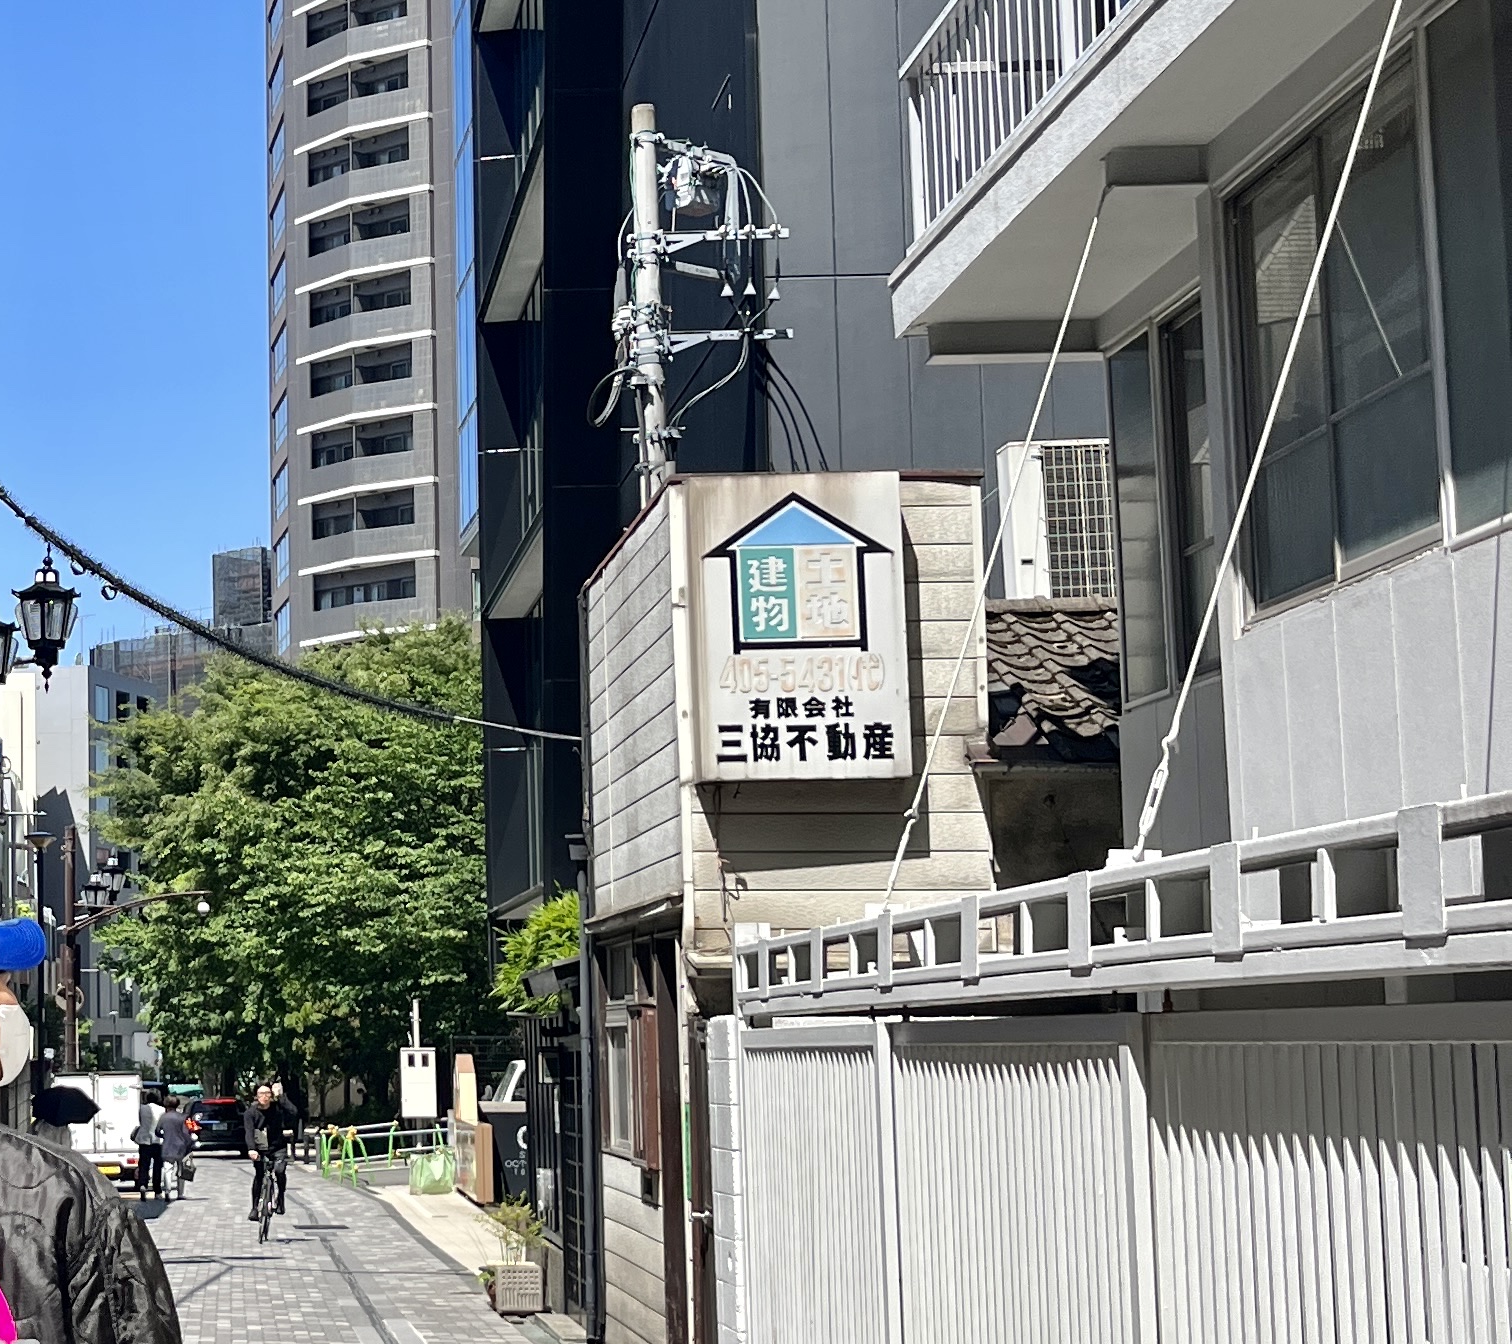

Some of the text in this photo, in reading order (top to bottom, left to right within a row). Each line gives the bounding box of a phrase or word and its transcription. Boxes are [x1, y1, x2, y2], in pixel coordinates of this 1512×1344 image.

[747, 555, 789, 632] 建物
[749, 696, 855, 719] 有限会社
[716, 722, 895, 764] 三協不動産
